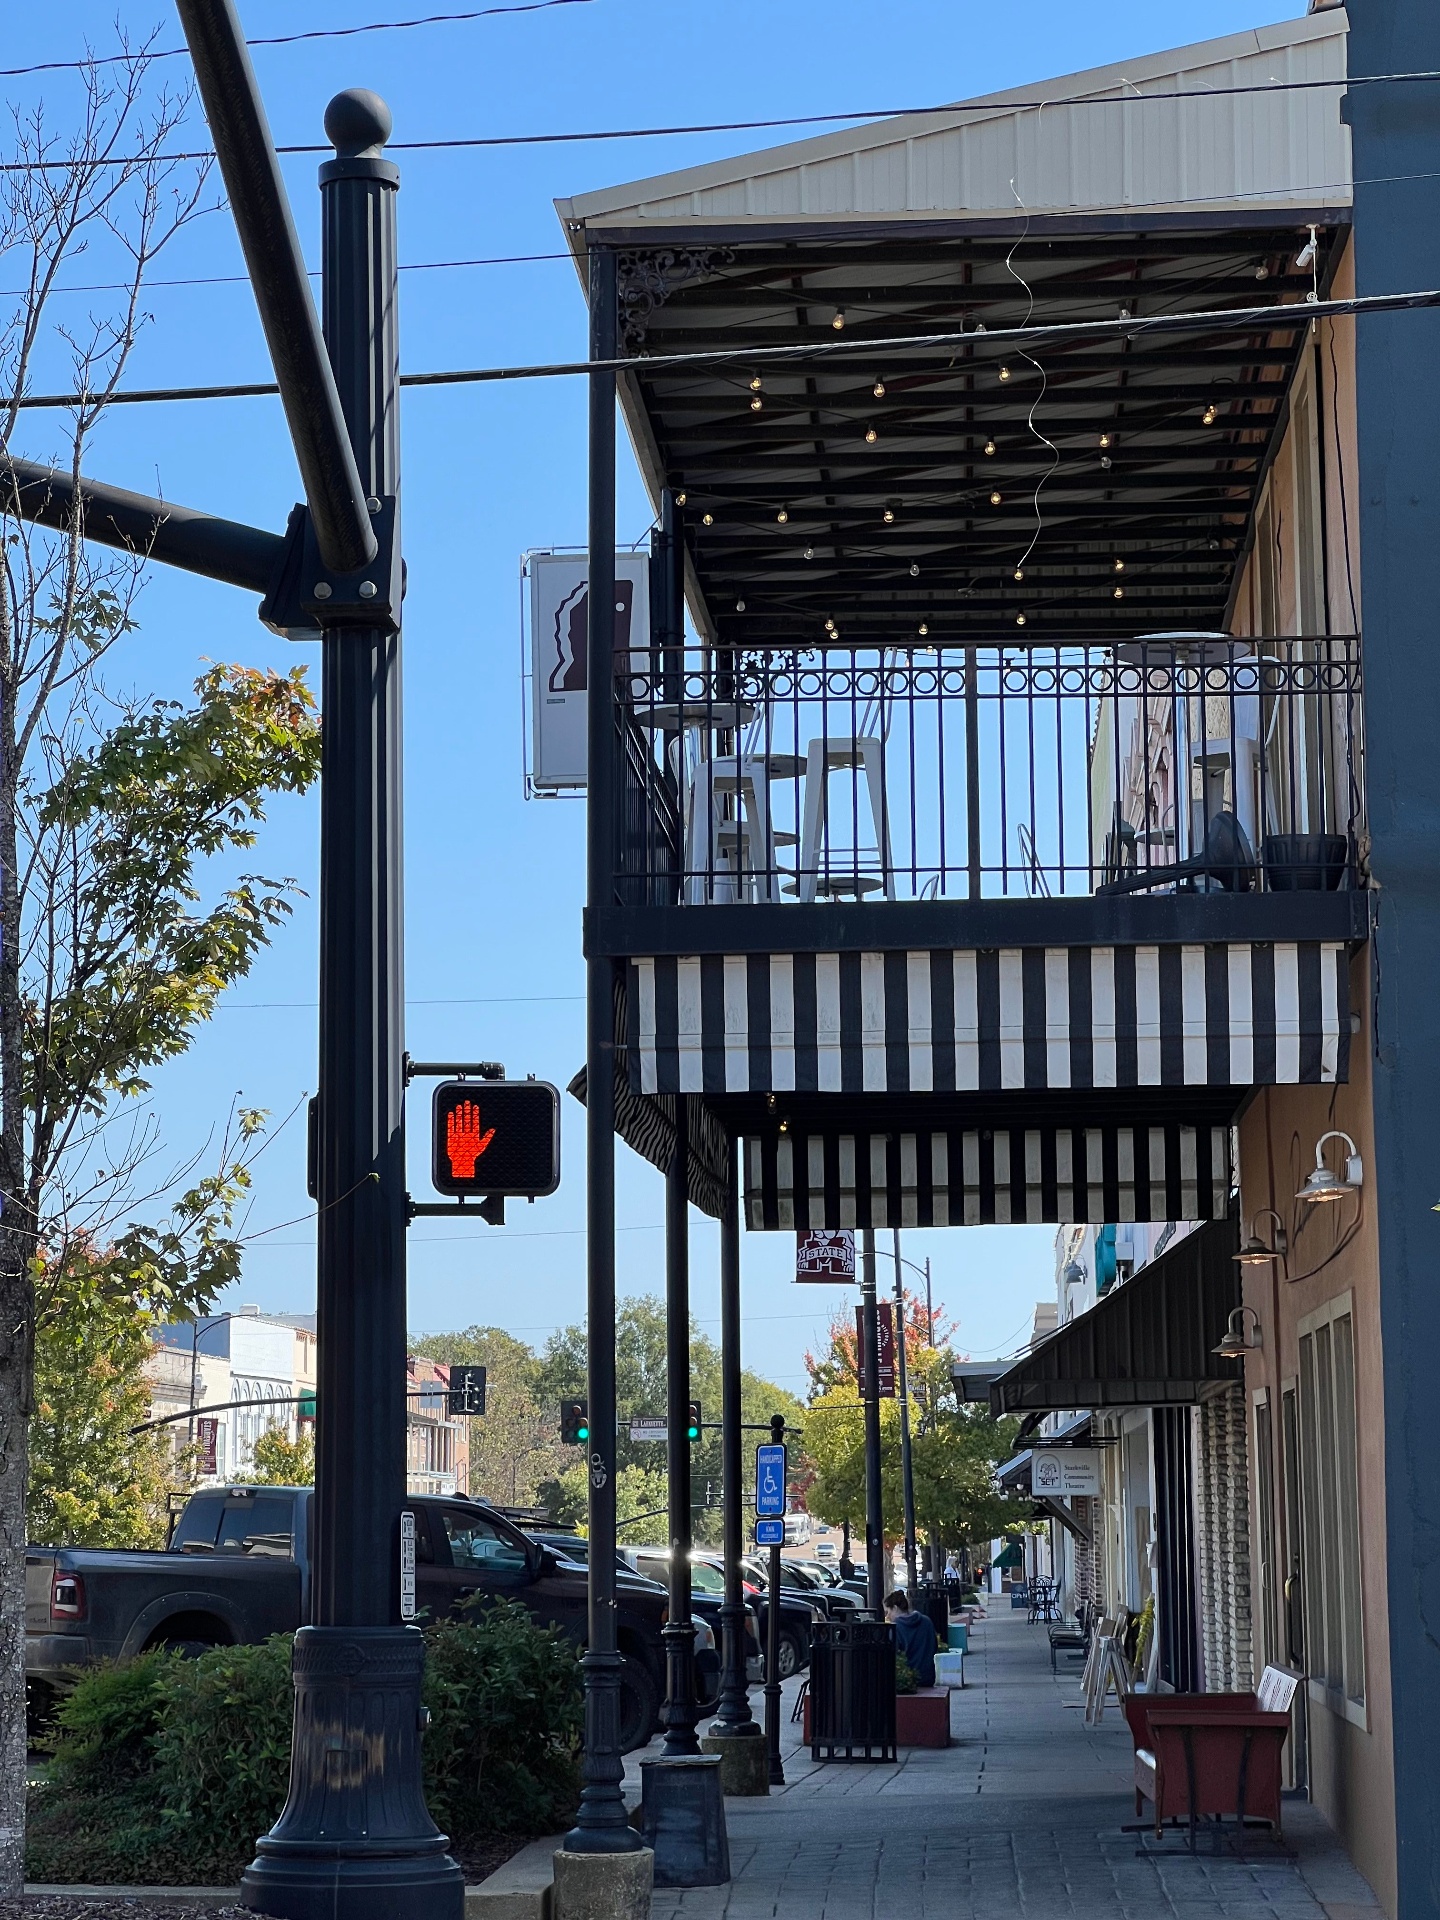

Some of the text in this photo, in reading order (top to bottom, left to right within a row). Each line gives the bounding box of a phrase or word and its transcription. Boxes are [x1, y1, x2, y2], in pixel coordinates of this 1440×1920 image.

[808, 1247, 843, 1259] STATE
[760, 1454, 782, 1464] HANDICAPPED
[1063, 1473, 1095, 1482] Community
[761, 1496, 779, 1506] PARKING
